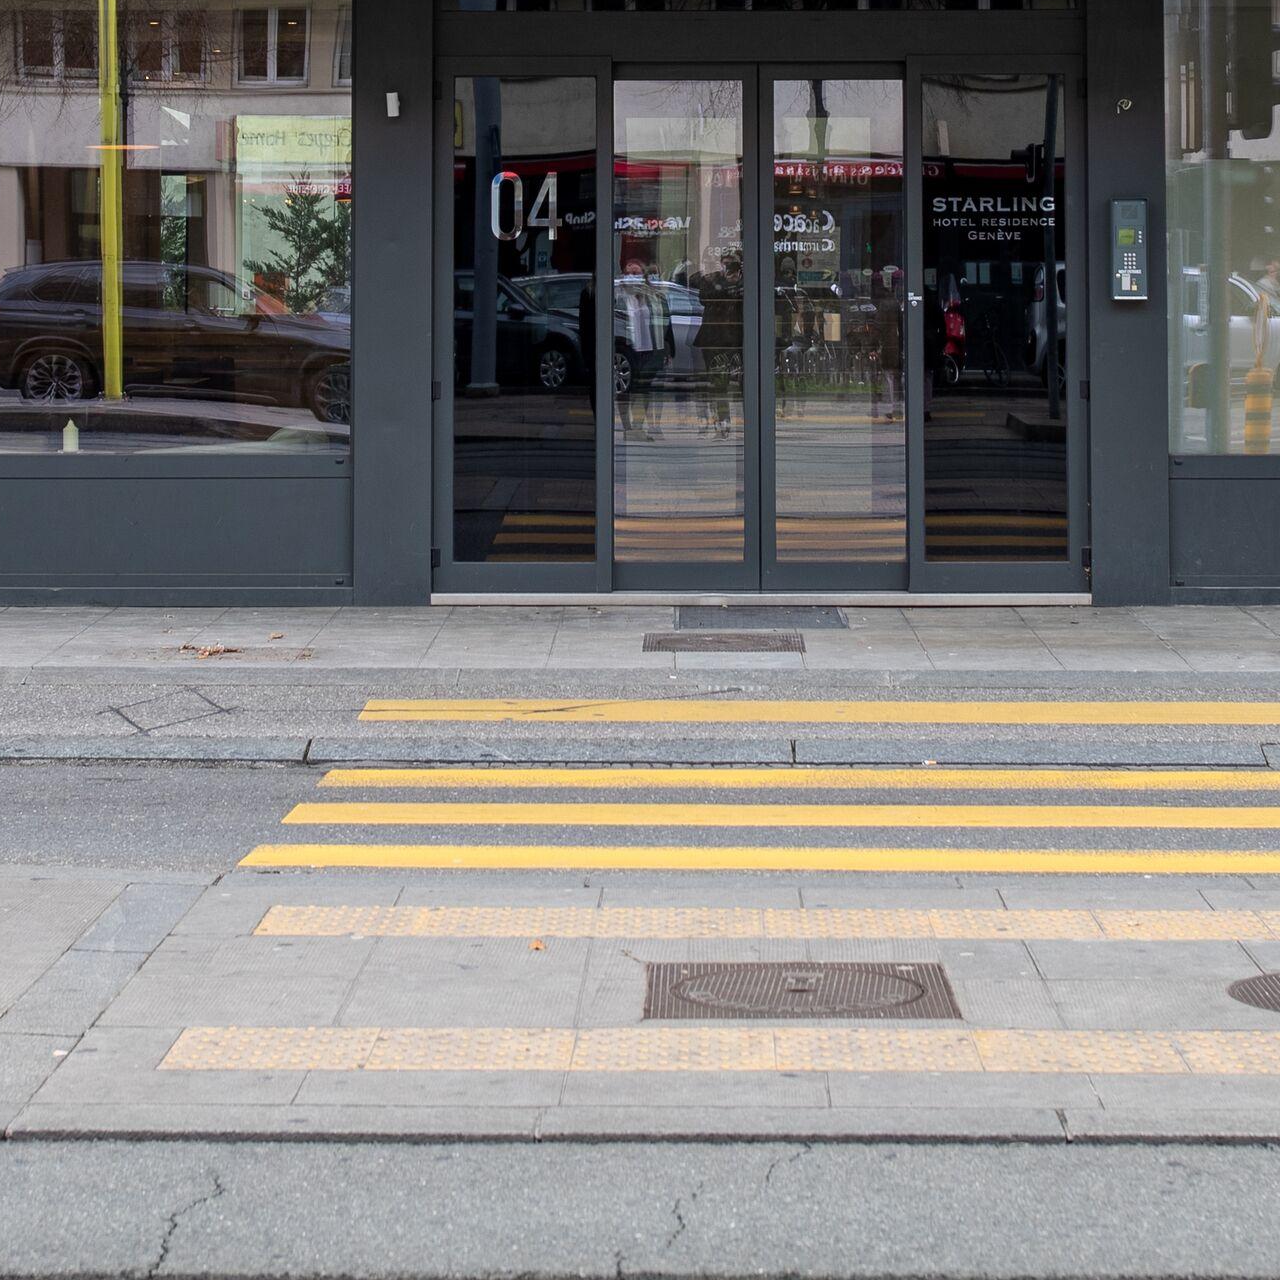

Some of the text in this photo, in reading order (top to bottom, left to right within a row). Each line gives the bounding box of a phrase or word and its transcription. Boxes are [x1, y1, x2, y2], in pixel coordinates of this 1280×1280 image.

[490, 170, 563, 241] 04
[932, 196, 1056, 212] STARLING
[932, 216, 1056, 227] HOTEL RESIDENCE
